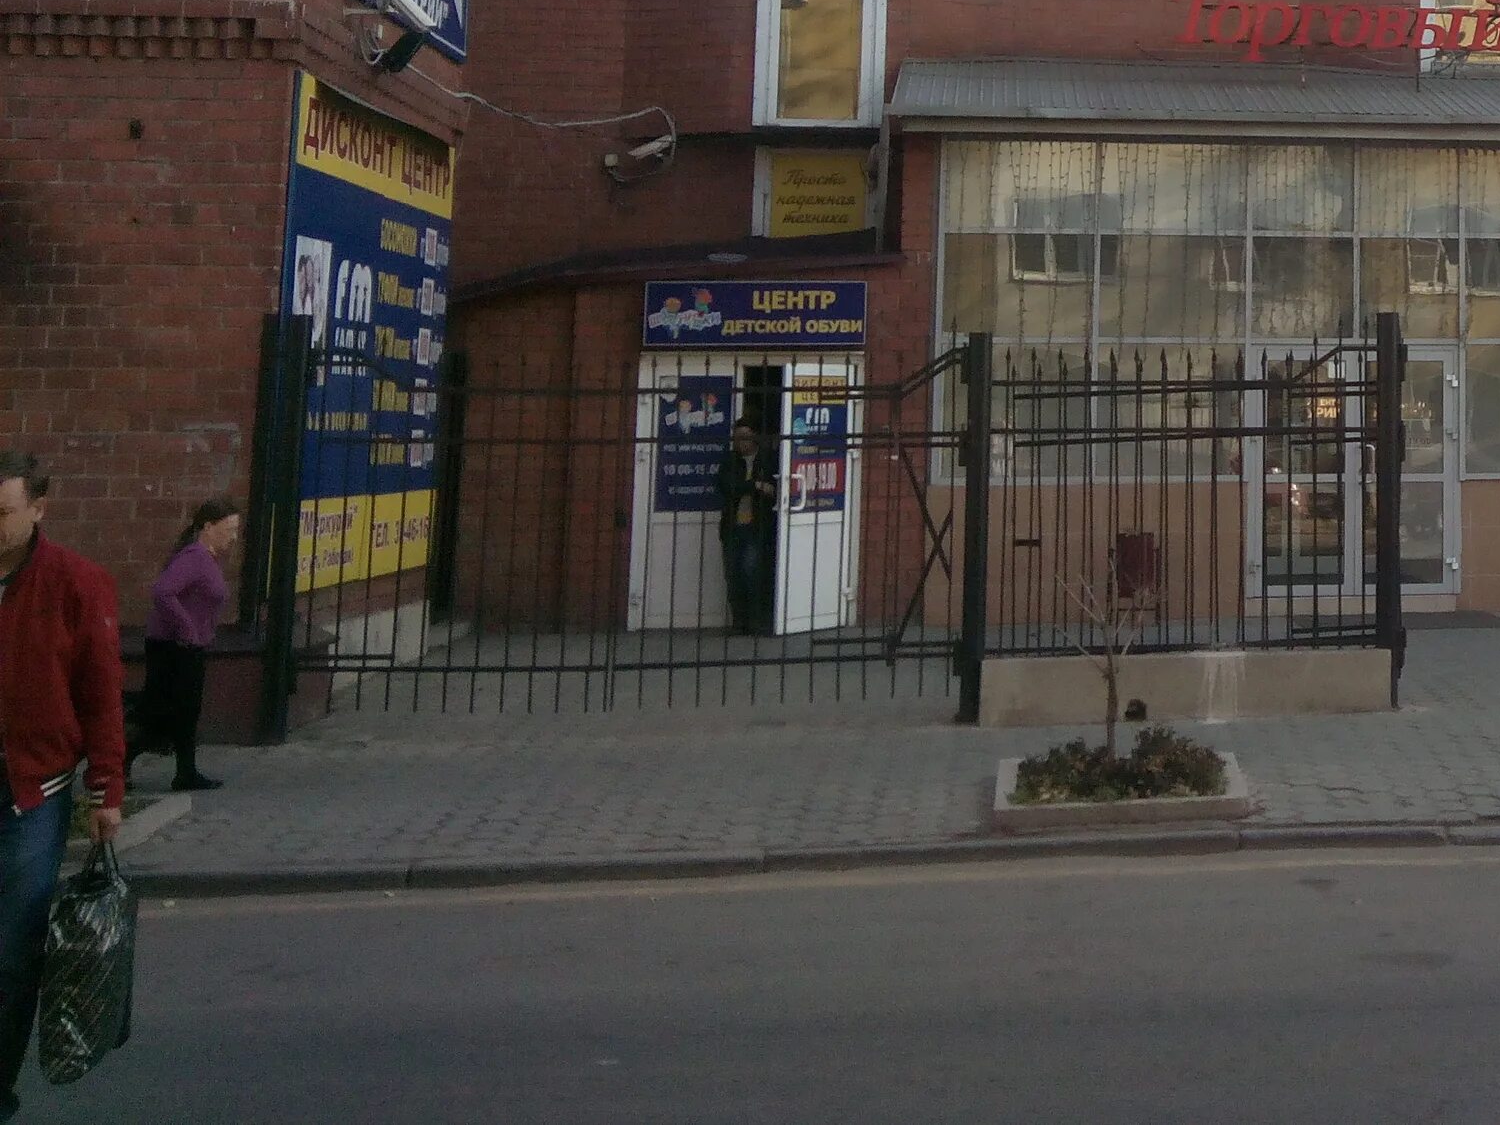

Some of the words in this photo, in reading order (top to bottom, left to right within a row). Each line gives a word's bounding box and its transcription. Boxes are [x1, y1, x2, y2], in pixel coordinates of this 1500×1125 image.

[303, 96, 399, 179] ДИСКОНТ
[401, 139, 450, 200] ЦЕНТР
[752, 289, 836, 313] ЦЕНТР
[721, 316, 801, 336] ДЕТСКОЙ
[806, 319, 862, 334] ОБУВИ
